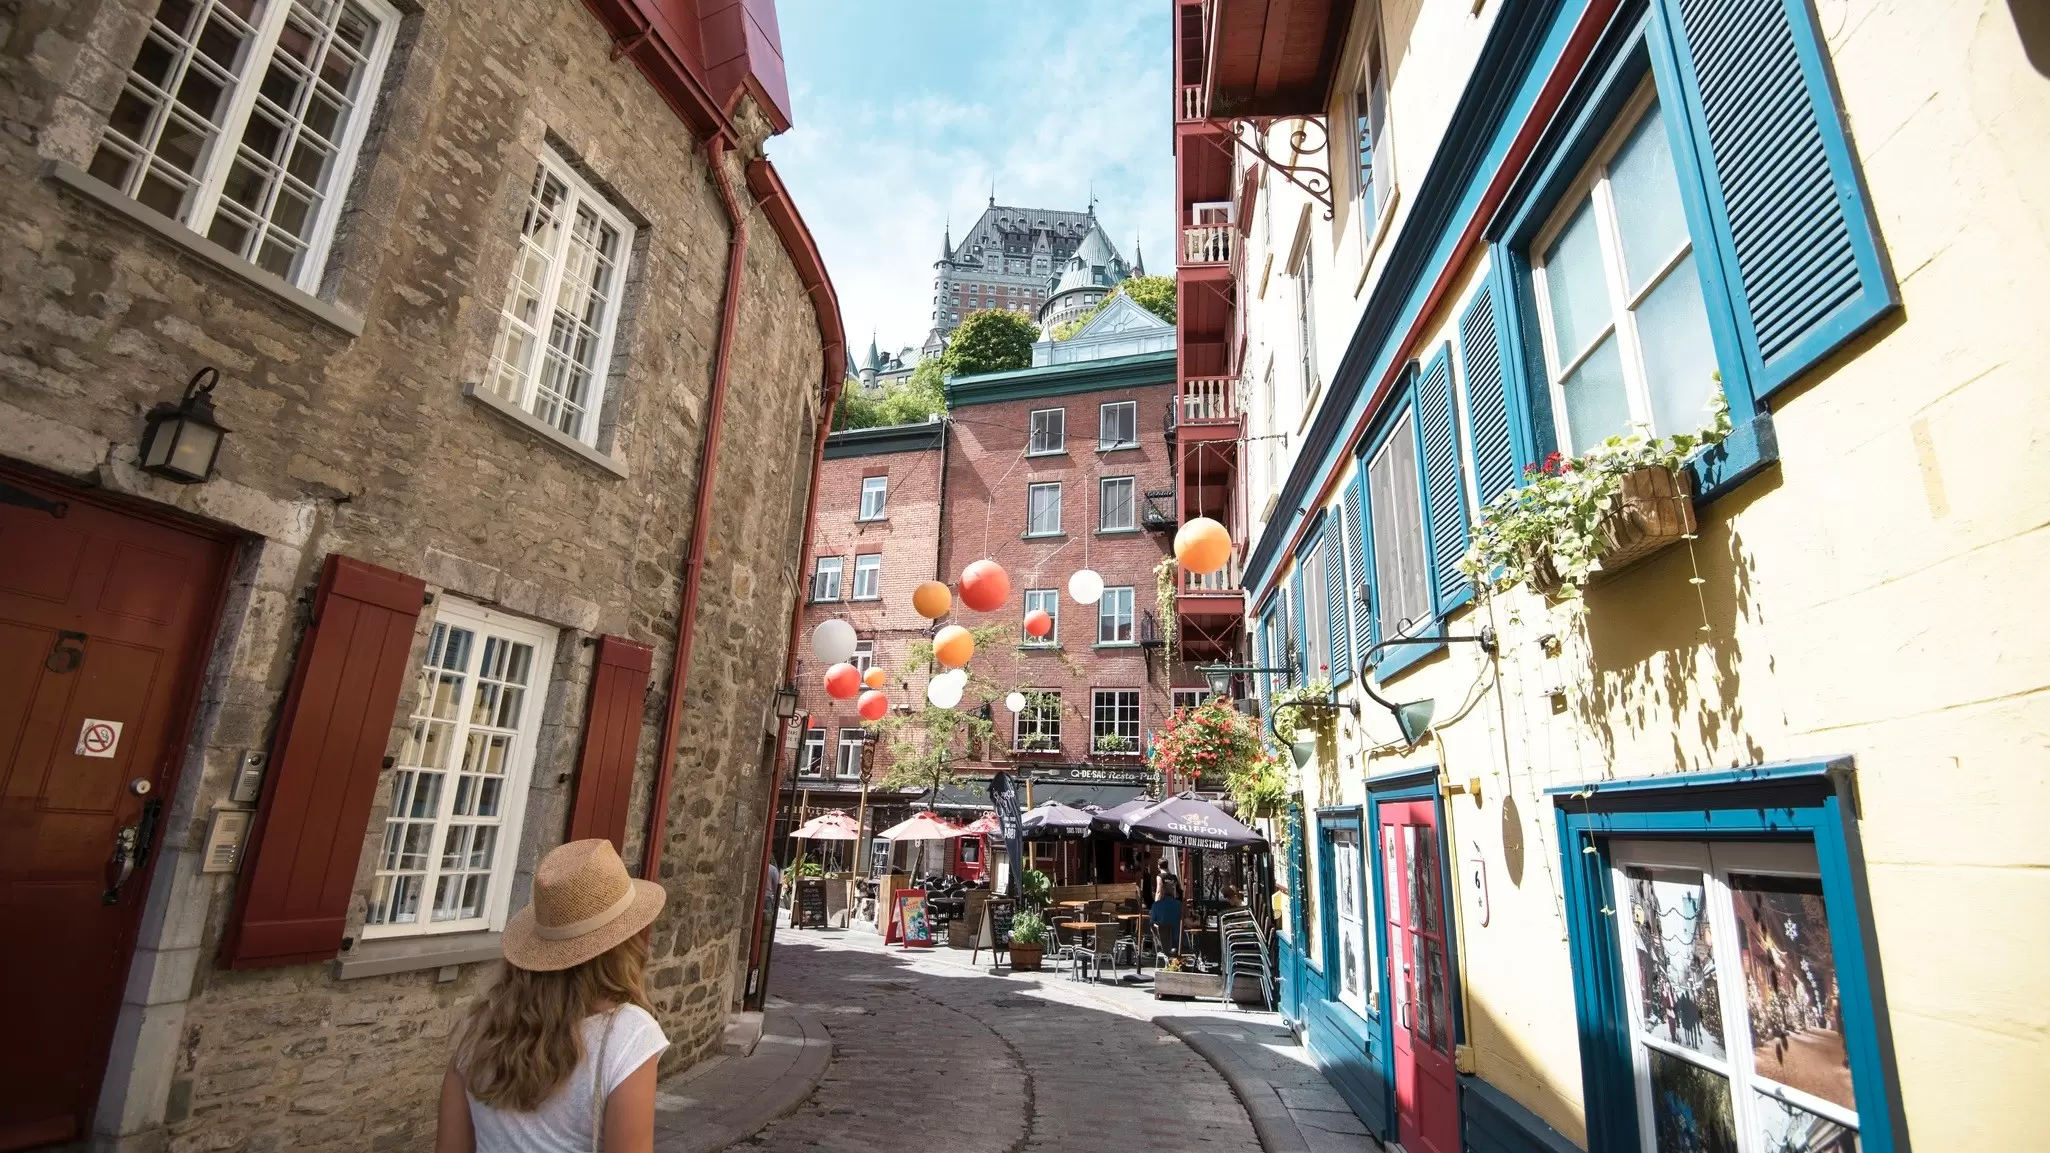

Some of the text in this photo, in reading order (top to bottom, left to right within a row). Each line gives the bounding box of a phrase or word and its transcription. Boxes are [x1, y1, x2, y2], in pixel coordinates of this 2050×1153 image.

[46, 629, 88, 674] 5
[1167, 822, 1228, 836] GRIFFON
[1168, 834, 1228, 850] SUIS TON INSTINCT
[1475, 871, 1480, 889] 6
